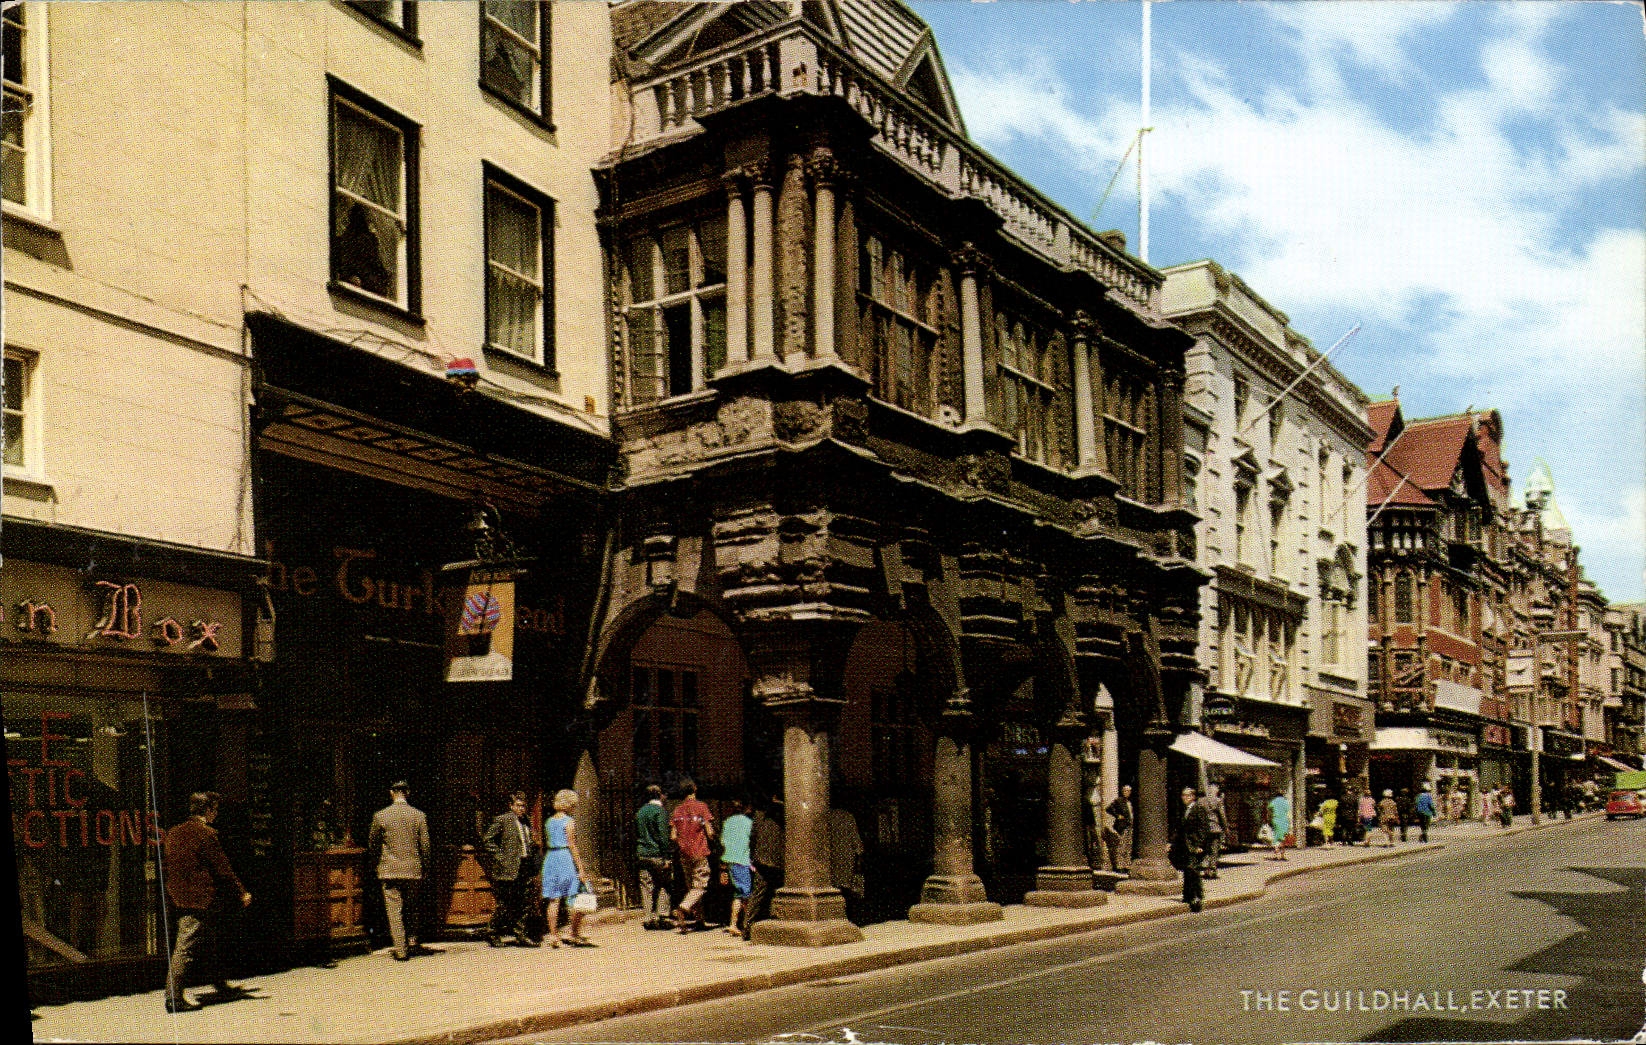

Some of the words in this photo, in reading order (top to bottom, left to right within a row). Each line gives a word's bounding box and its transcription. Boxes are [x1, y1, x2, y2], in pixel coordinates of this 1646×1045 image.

[261, 538, 318, 597] he
[332, 545, 446, 615] Turk
[88, 580, 222, 650] Box
[7, 711, 72, 768] E
[7, 767, 88, 808] TIC
